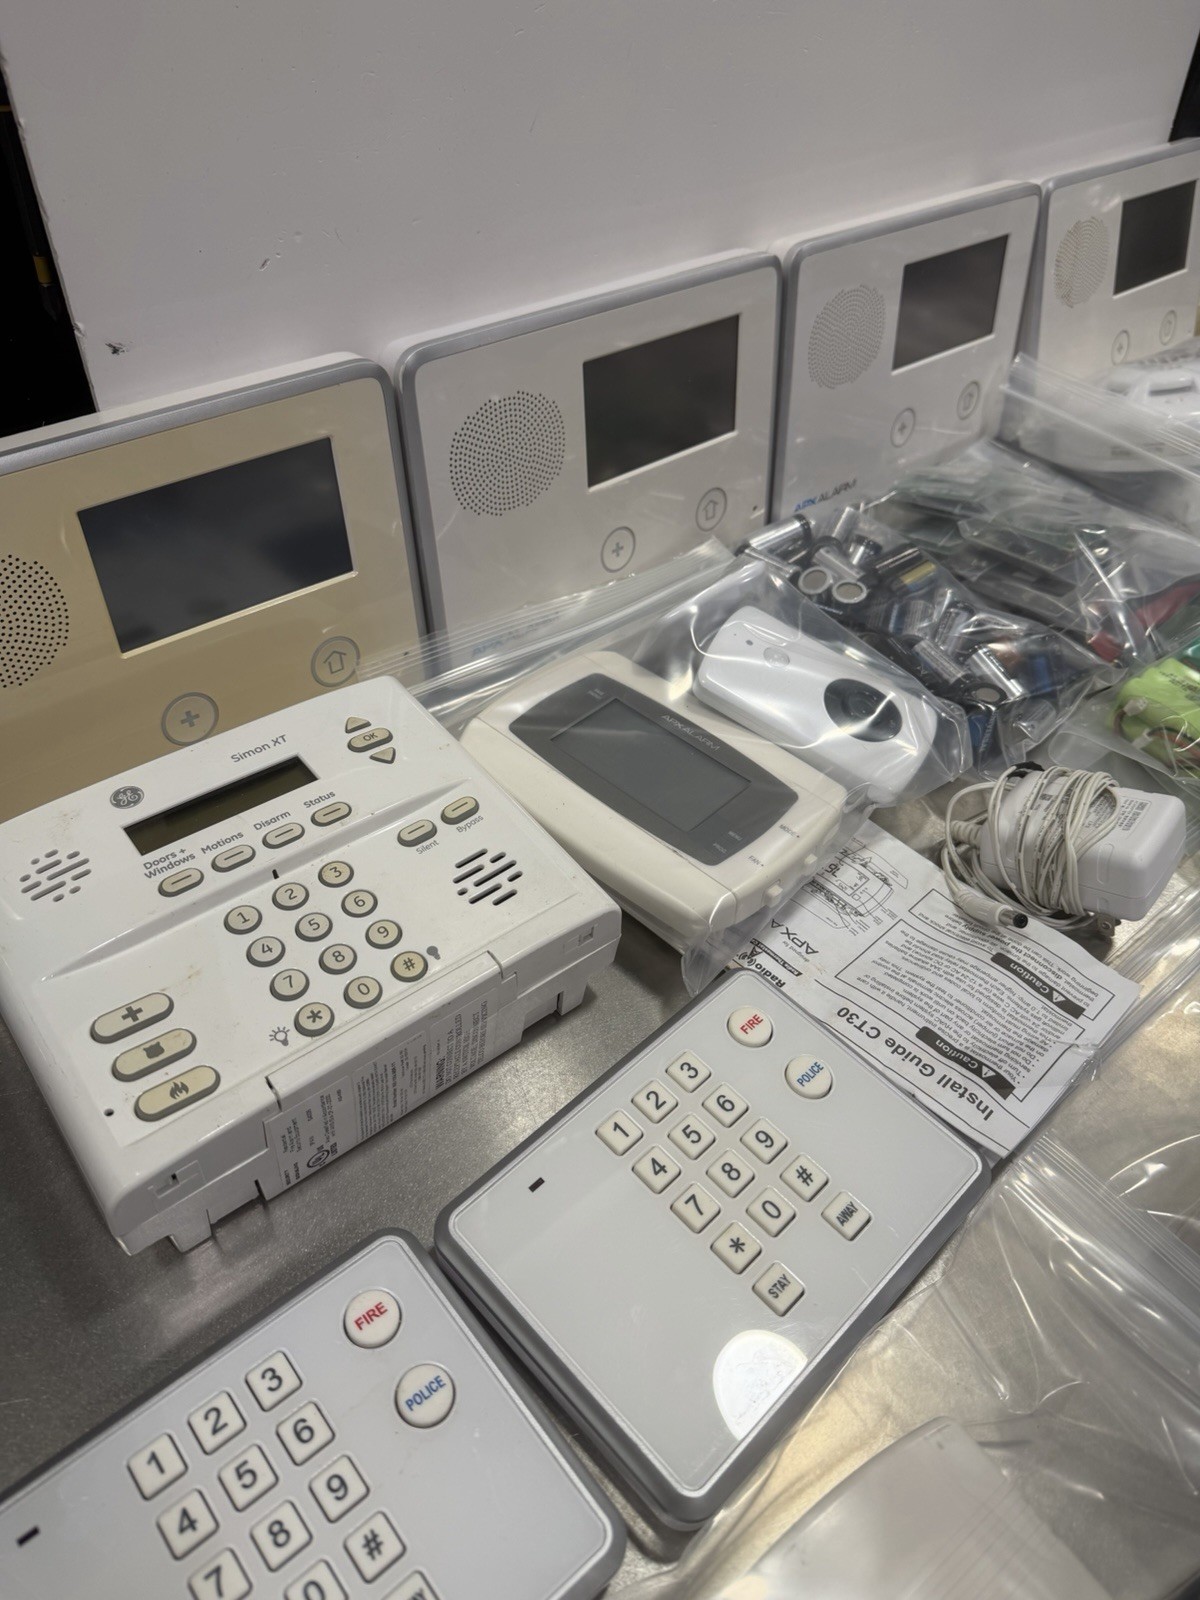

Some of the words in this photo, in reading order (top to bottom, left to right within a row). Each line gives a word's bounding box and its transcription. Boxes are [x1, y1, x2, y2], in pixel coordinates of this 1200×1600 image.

[363, 732, 378, 741] OK
[230, 744, 271, 763] Simon
[270, 735, 287, 749] XT
[303, 790, 335, 809] Status
[254, 810, 291, 831] Disarm
[456, 815, 484, 833] Bypass
[201, 831, 243, 854] Motions
[416, 840, 439, 854] Silent
[143, 852, 177, 870] Doors
[144, 853, 196, 880] Windows
[237, 912, 250, 924] 1
[285, 888, 297, 899] 2
[330, 866, 342, 878] 3
[262, 943, 273, 954] 4
[308, 918, 320, 930] 5
[354, 896, 365, 907] 6
[781, 939, 790, 949] for
[987, 933, 1010, 946] power
[283, 975, 293, 988] 7
[333, 951, 345, 962] 8
[377, 926, 389, 938] 9
[788, 944, 810, 963] designed
[752, 961, 786, 988] Radio
[870, 957, 890, 972] control
[1021, 950, 1064, 980] disconnect
[357, 983, 370, 995] 0
[403, 957, 415, 971] #
[869, 975, 895, 994] installing
[906, 975, 933, 994] terminals
[1009, 961, 1050, 994] Caution
[868, 983, 880, 993] with
[894, 990, 913, 1004] before
[918, 990, 933, 1001] work
[931, 990, 954, 1007] electric
[934, 984, 947, 995] test
[960, 986, 975, 998] local
[973, 987, 1002, 1010] designed
[884, 992, 905, 1007] handle
[912, 1001, 935, 1018] system
[932, 998, 946, 1009] until
[951, 996, 986, 1021] conditioner
[980, 1000, 1007, 1020] conform
[835, 1004, 881, 1041] CT30
[933, 1015, 952, 1030] HVAC
[939, 1011, 953, 1022] part
[952, 1004, 974, 1021] across
[954, 1013, 970, 1026] back
[1006, 1011, 1038, 1034] thermostat
[740, 1014, 764, 1035] FIRE
[935, 1025, 960, 1044] precise
[968, 1023, 998, 1045] electricity
[1005, 1018, 1021, 1030] must
[970, 1032, 1003, 1056] thermostat
[997, 1041, 1010, 1052] turn
[998, 1035, 1014, 1048] short
[1000, 1029, 1024, 1046] furnace
[881, 1035, 936, 1079] Guide
[933, 1038, 978, 1070] Caution
[968, 1038, 998, 1060] electricity
[969, 1047, 1003, 1070] thermostat
[1002, 1051, 1032, 1072] servicing
[1006, 1062, 1022, 1076] Turn
[797, 1062, 824, 1087] POLICE
[1001, 1068, 1017, 1082] Your
[614, 1122, 629, 1137] 1
[646, 1091, 666, 1110] 2
[680, 1062, 698, 1078] 3
[935, 1071, 993, 1122] Install
[652, 1158, 667, 1175] 4
[682, 1125, 701, 1143] 5
[717, 1095, 734, 1112] 6
[685, 1194, 703, 1215] 7
[722, 1163, 740, 1180] 8
[756, 1131, 774, 1148] 9
[762, 1201, 781, 1218] 0
[796, 1166, 813, 1186] #
[768, 1274, 791, 1299] STAY
[836, 1201, 858, 1226] AWAY
[354, 1302, 387, 1330] FIRE
[405, 1375, 446, 1411] POLICE
[147, 1452, 165, 1474] 1
[204, 1407, 228, 1435] 2
[261, 1367, 283, 1392] 3
[179, 1508, 197, 1534] 4
[236, 1460, 257, 1488] 5
[294, 1419, 314, 1443] 6
[204, 1566, 223, 1598] 7
[268, 1520, 290, 1547] 8
[327, 1475, 348, 1500] 9
[303, 1581, 325, 1600] 0
[362, 1530, 383, 1560] #
